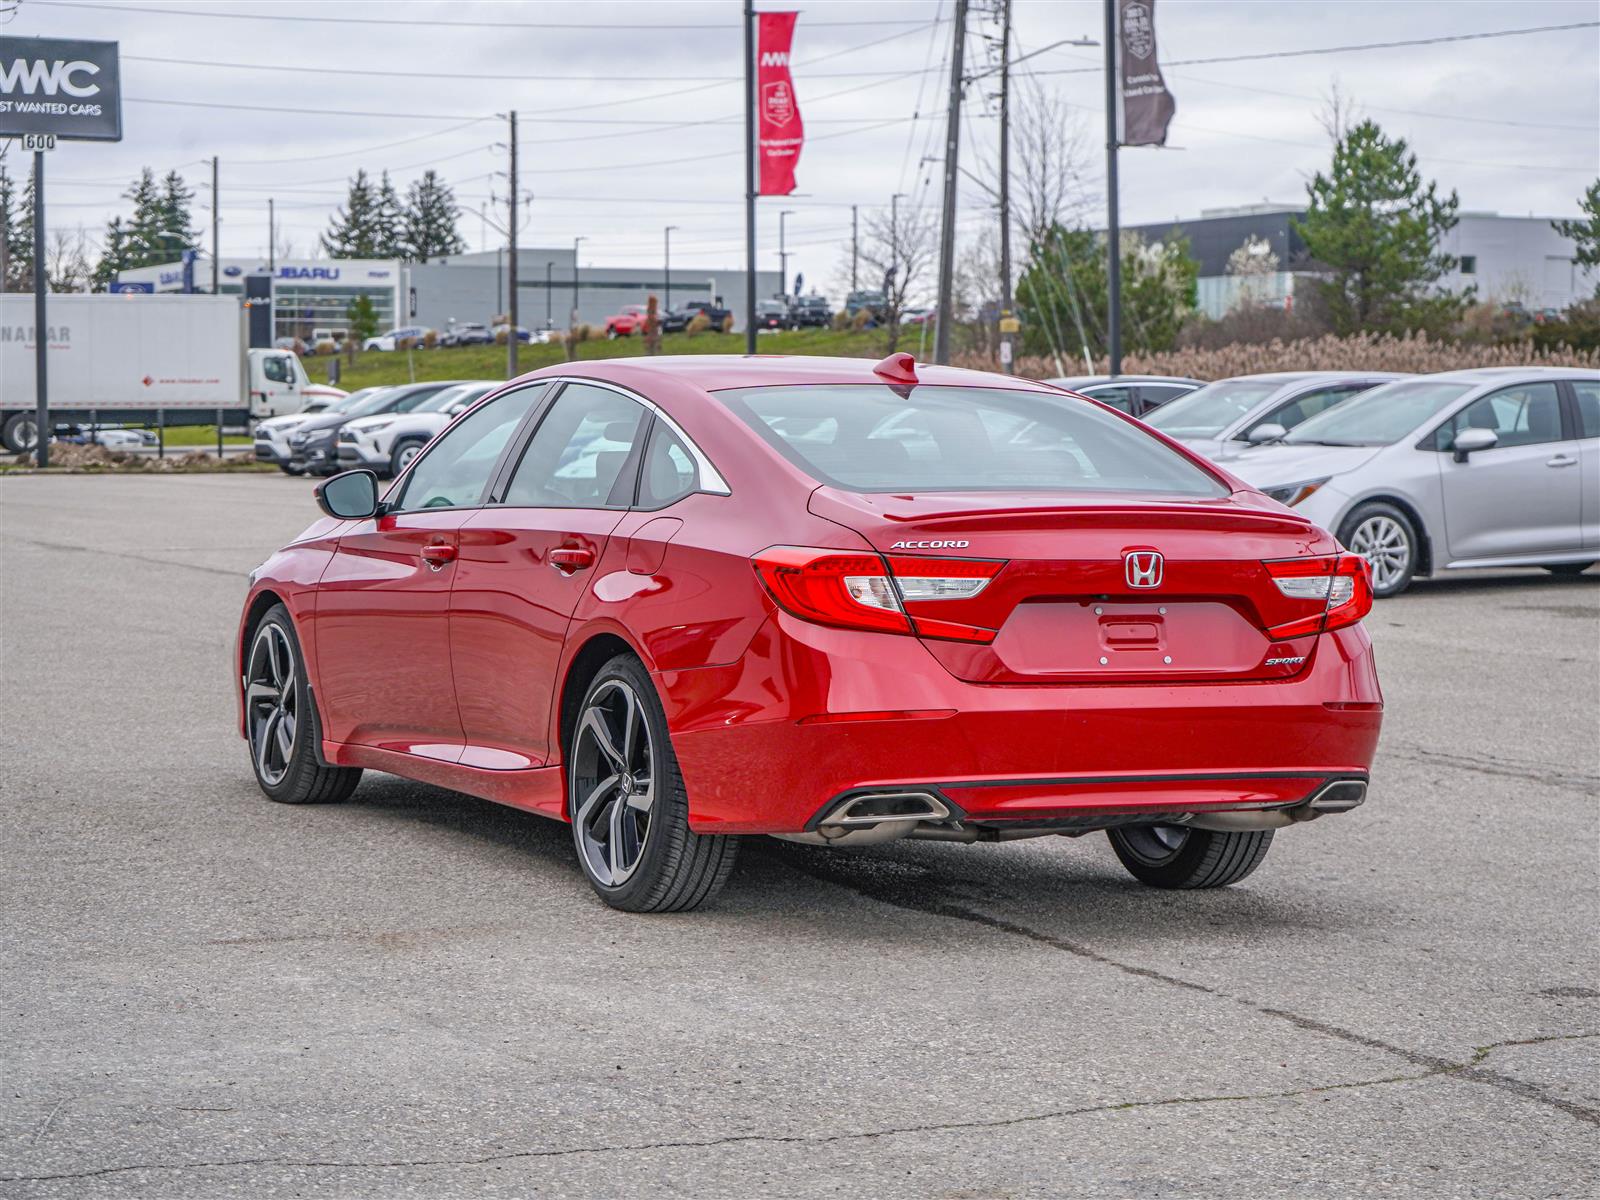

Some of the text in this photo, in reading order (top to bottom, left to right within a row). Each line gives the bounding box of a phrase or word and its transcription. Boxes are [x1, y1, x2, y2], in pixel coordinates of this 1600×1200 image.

[14, 102, 68, 115] WANTED
[68, 104, 102, 116] CARS
[26, 134, 55, 149] 600
[258, 266, 340, 280] UBARU
[890, 540, 970, 550] ACCORD
[1264, 656, 1306, 666] SPORT
